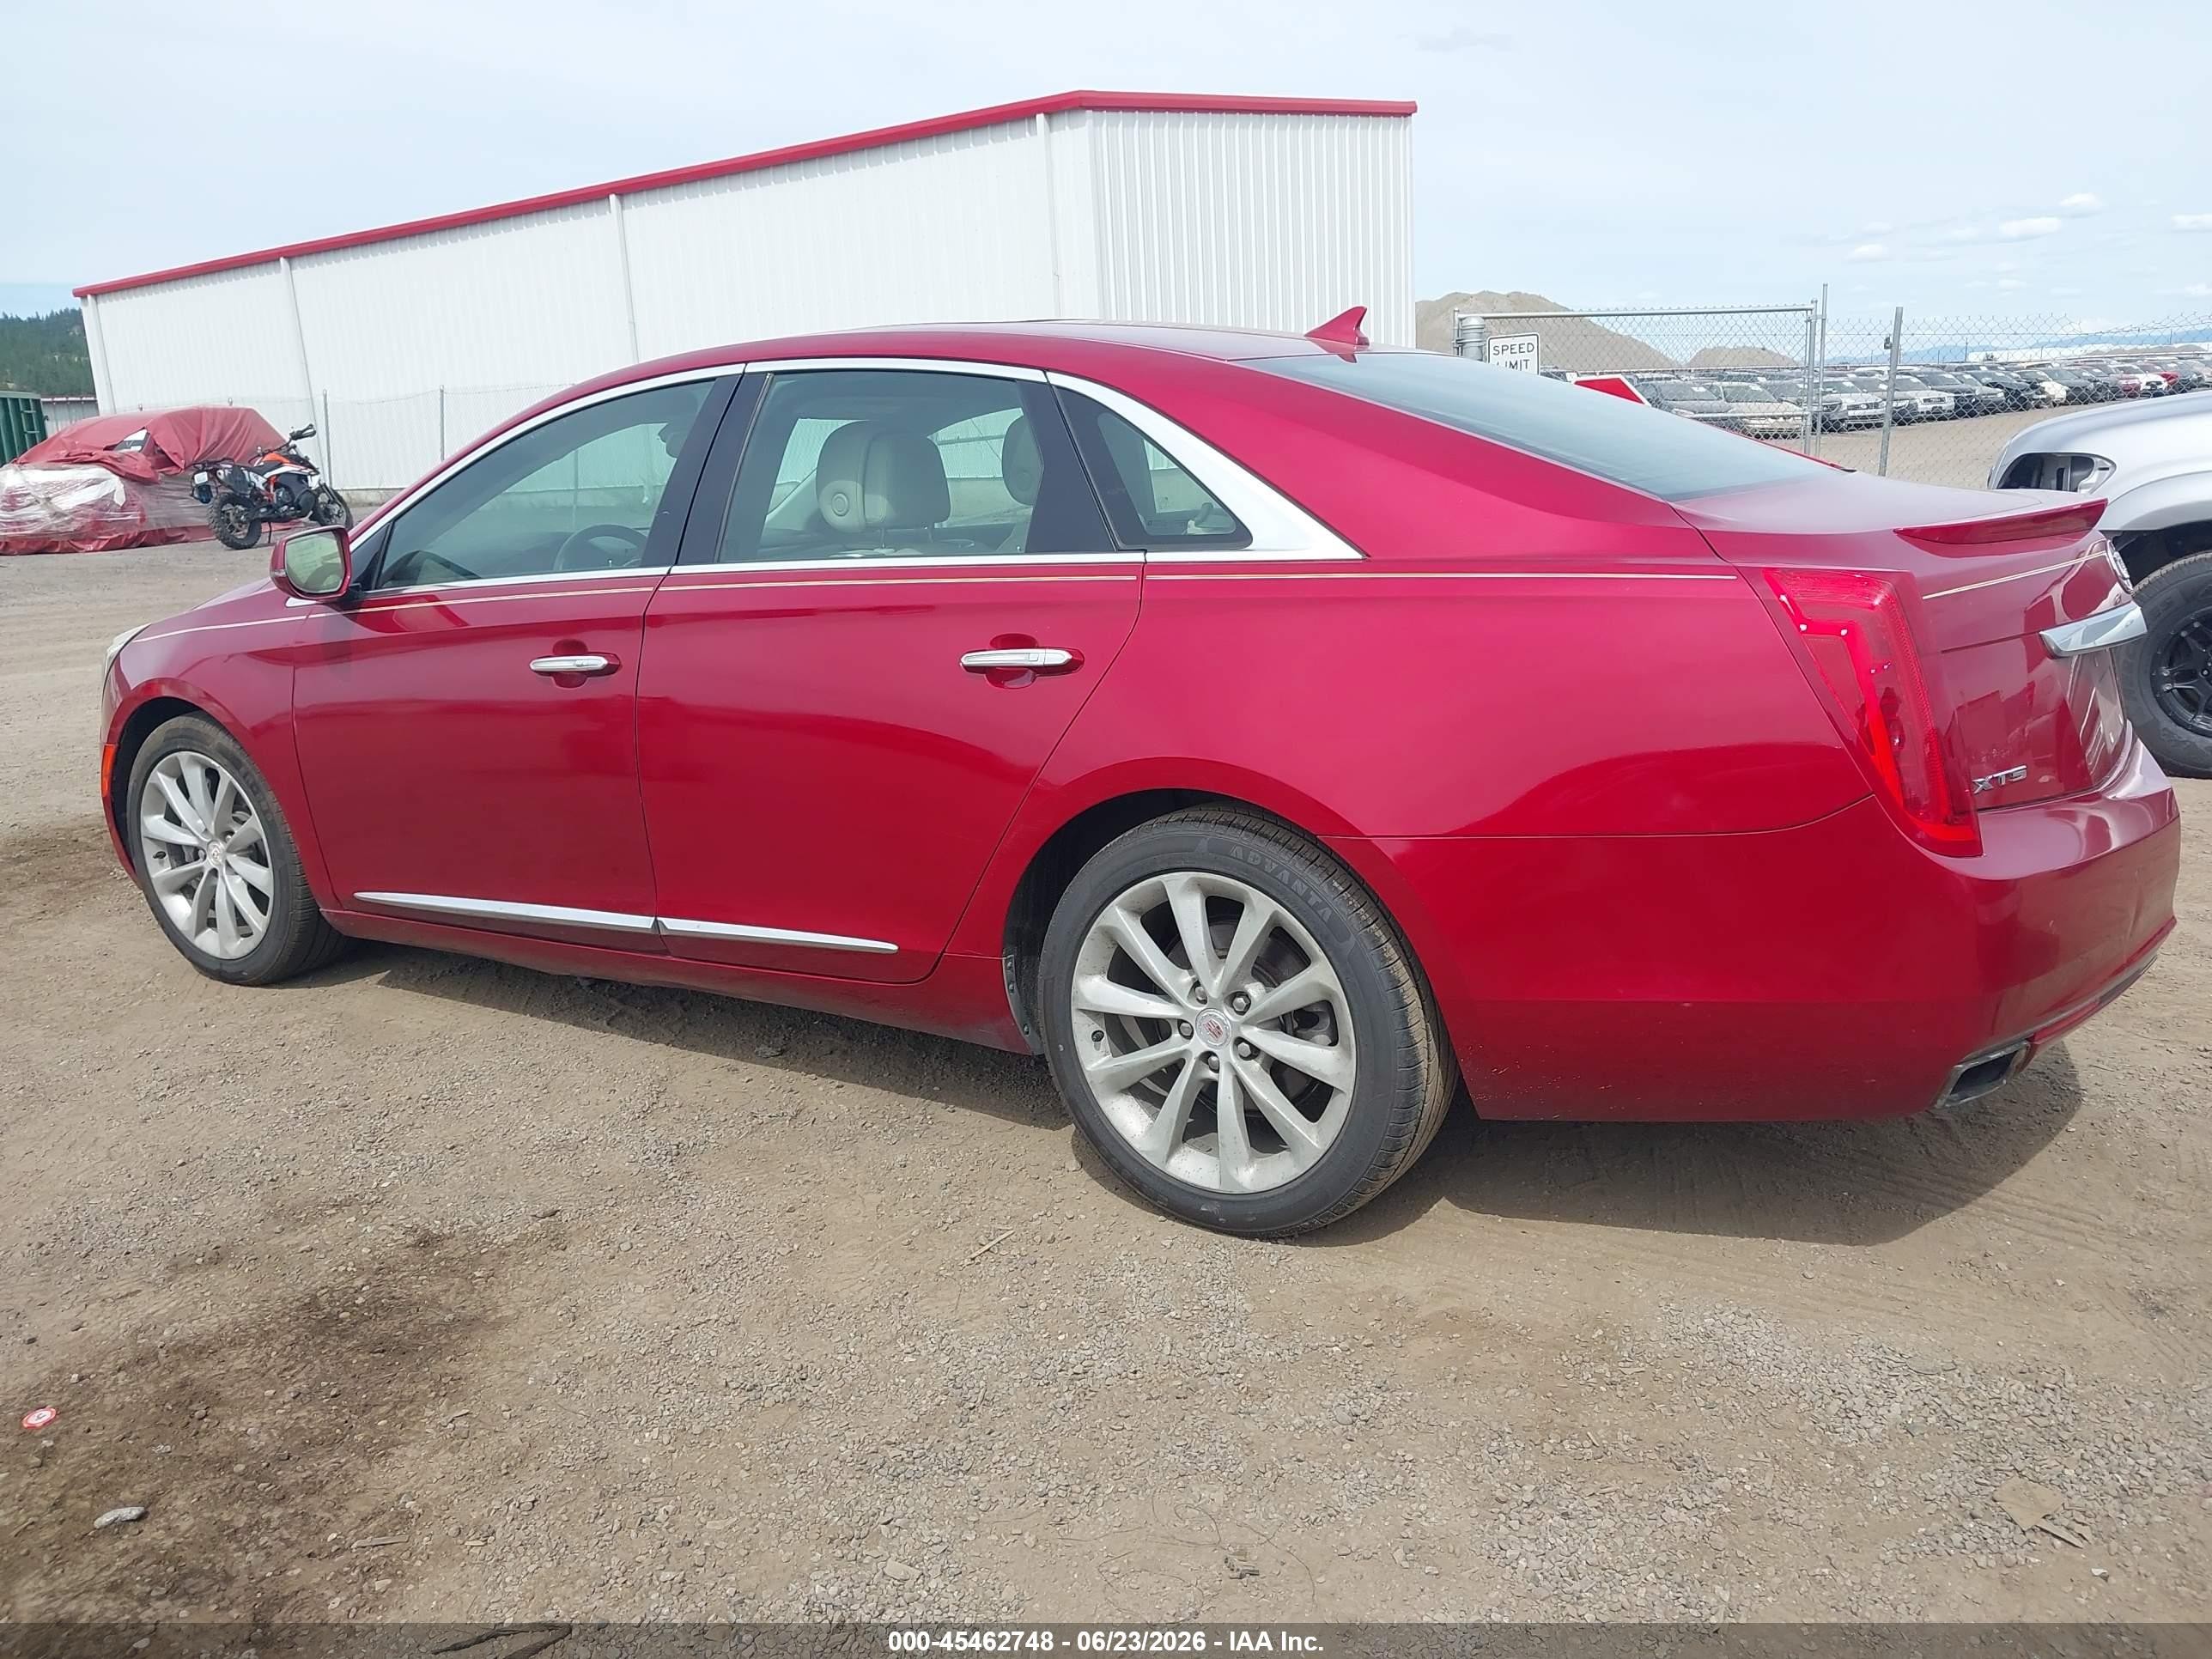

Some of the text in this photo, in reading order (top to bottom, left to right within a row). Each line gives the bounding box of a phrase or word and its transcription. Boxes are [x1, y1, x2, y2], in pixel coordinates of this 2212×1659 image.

[1492, 343, 1534, 356] SPEED
[1972, 764, 2027, 793] XTS
[1231, 845, 1334, 922] ADVANTA
